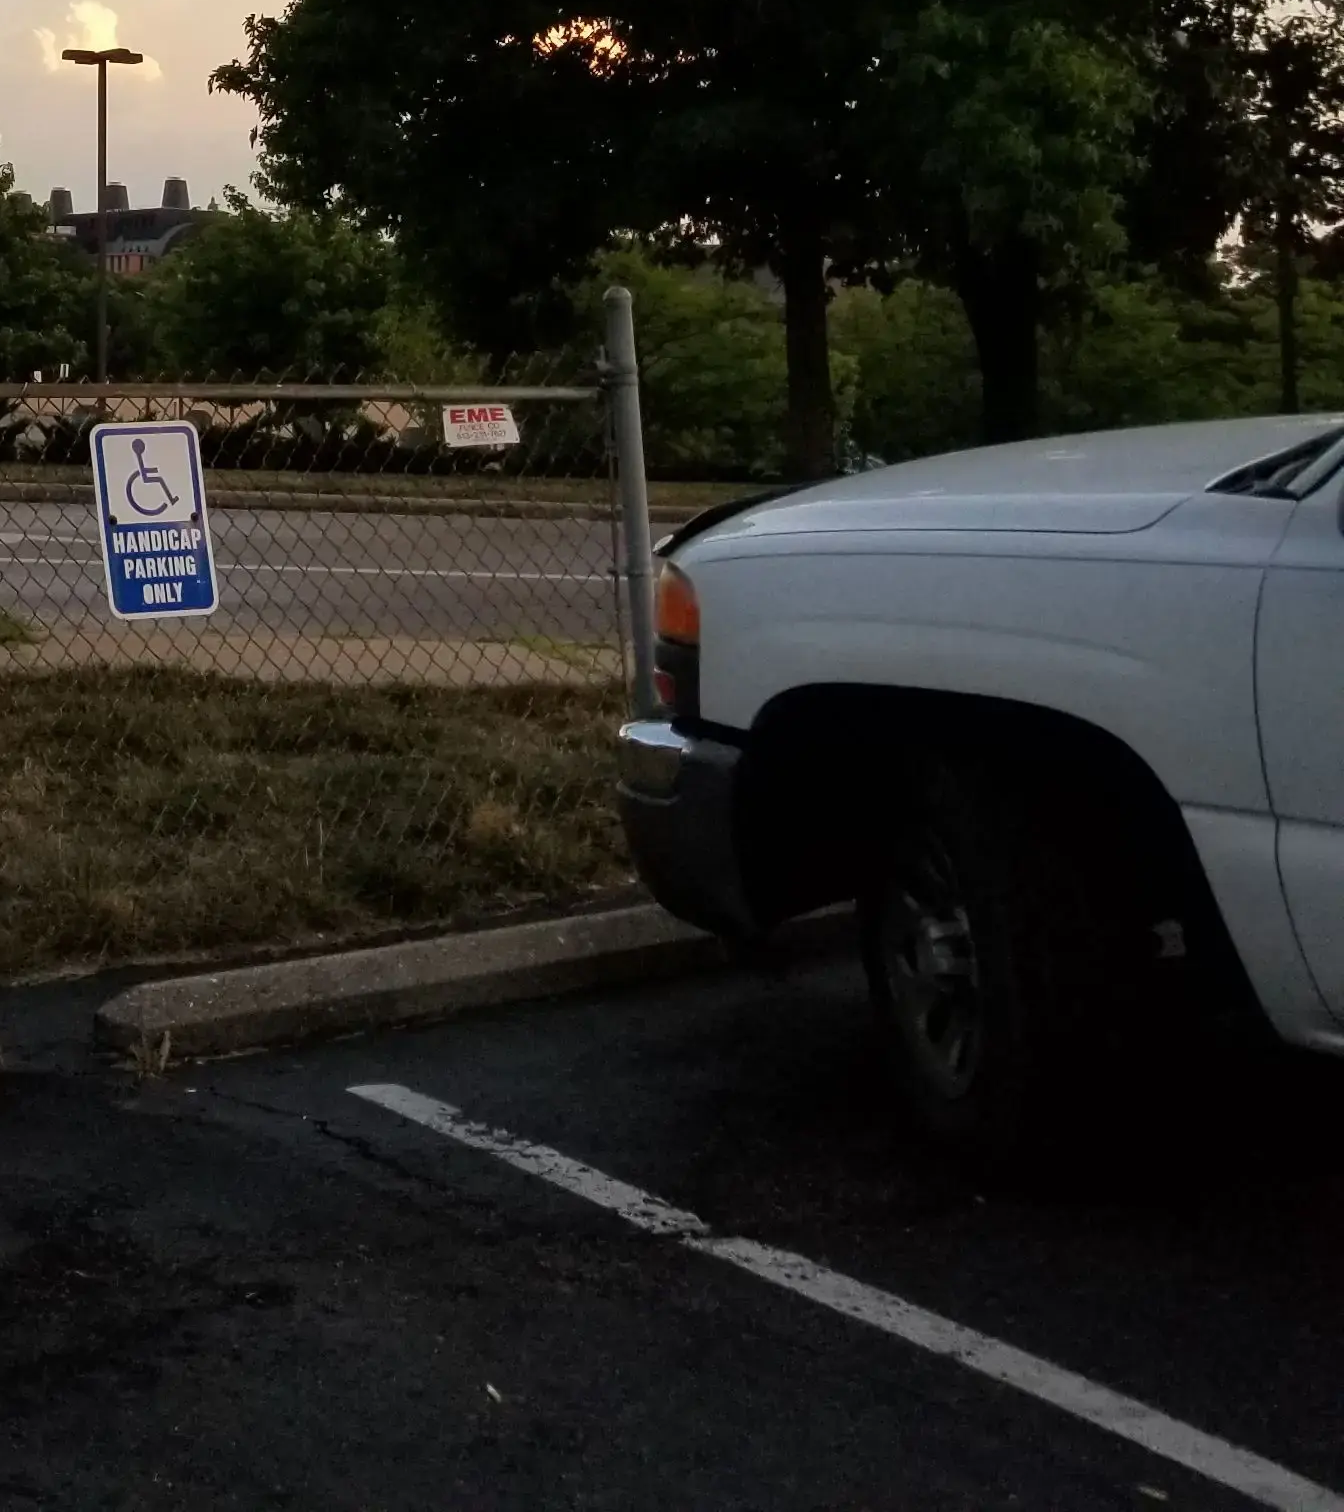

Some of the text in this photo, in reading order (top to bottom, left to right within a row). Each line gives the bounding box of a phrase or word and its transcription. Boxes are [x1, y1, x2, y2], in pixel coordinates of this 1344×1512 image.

[449, 407, 507, 424] EME
[112, 528, 201, 554] HANDICAP
[123, 555, 197, 580] PARKING
[142, 581, 183, 605] ONLY
